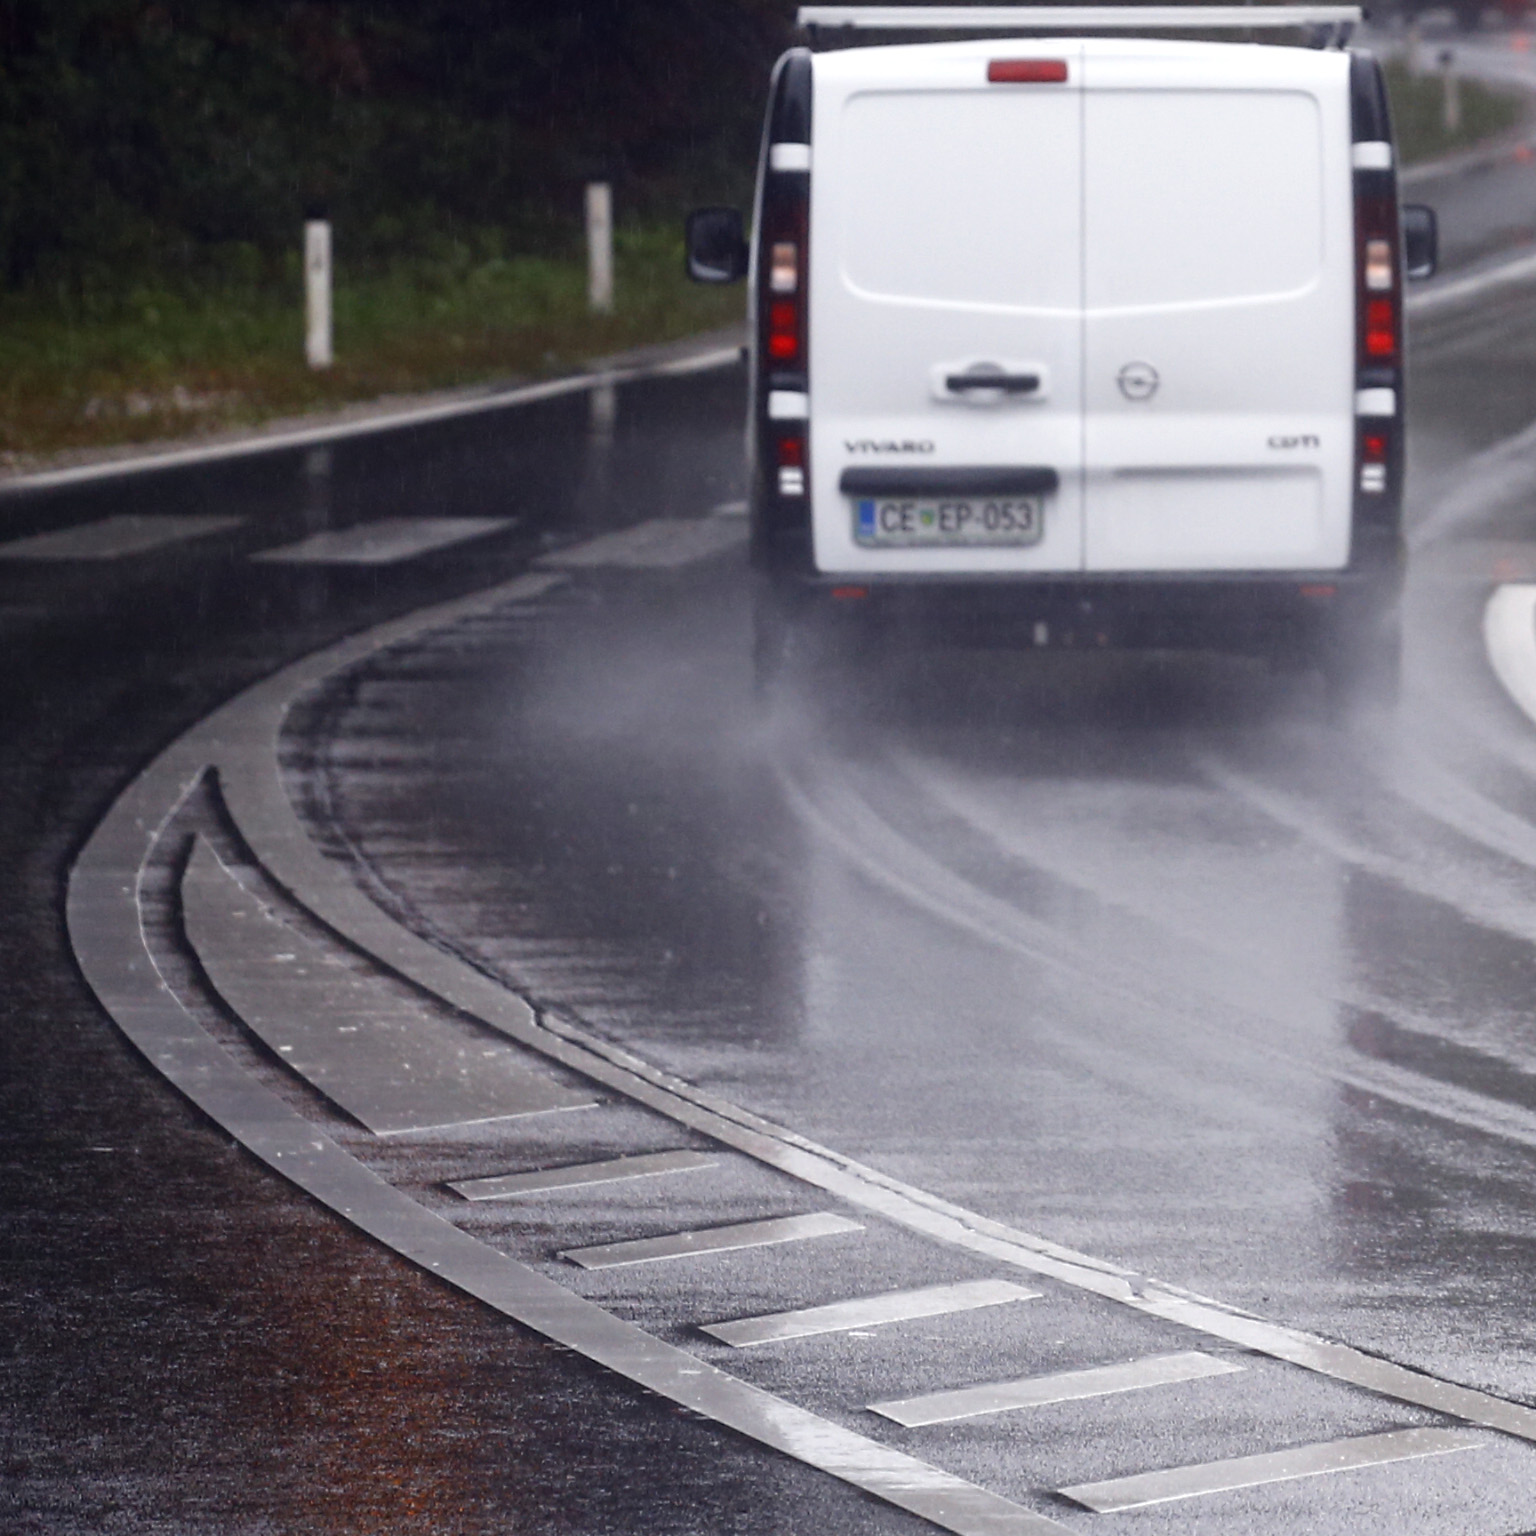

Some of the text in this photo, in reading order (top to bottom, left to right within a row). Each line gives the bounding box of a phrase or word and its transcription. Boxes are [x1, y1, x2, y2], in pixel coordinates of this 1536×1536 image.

[844, 439, 935, 454] VIVARO
[880, 502, 1033, 533] CE EP-053
